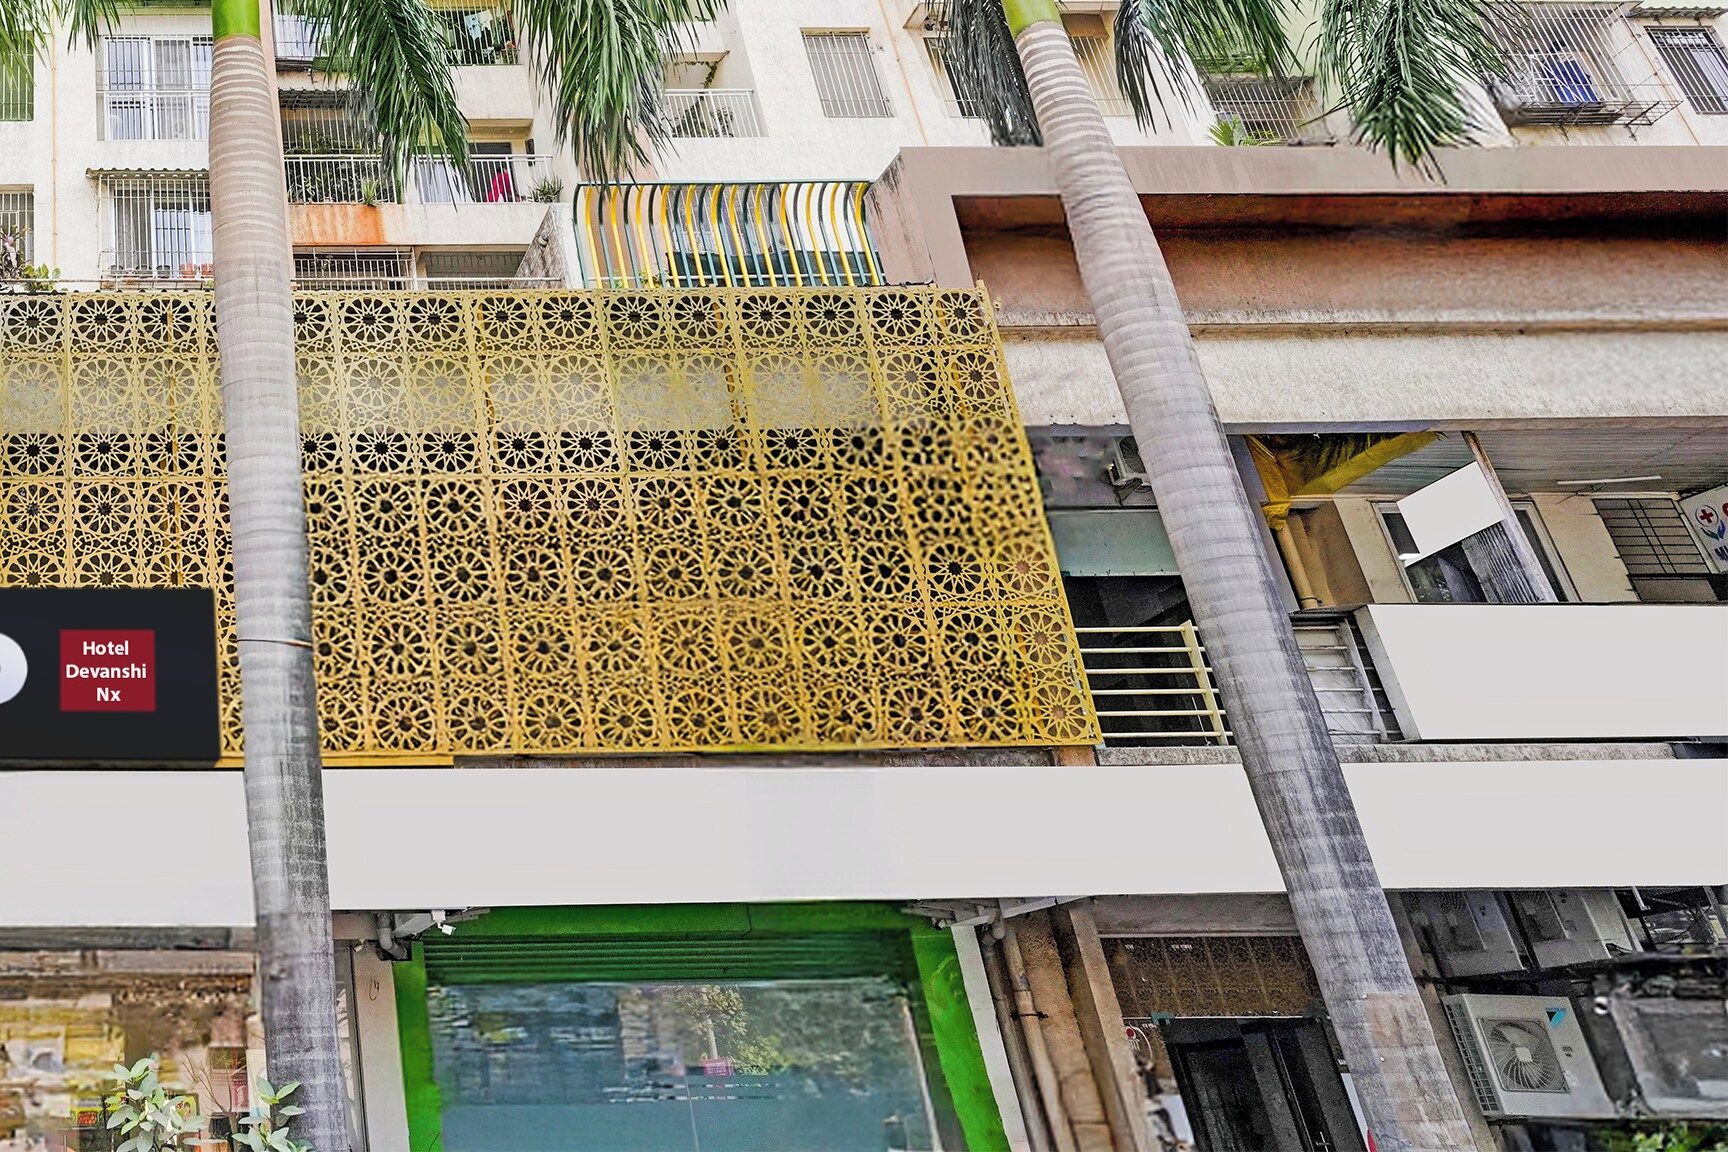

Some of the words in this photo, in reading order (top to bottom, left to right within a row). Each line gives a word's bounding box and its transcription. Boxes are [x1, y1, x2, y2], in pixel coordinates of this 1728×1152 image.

[82, 640, 129, 656] Hotel
[65, 663, 147, 679] Devanshi
[96, 687, 122, 702] Nx
